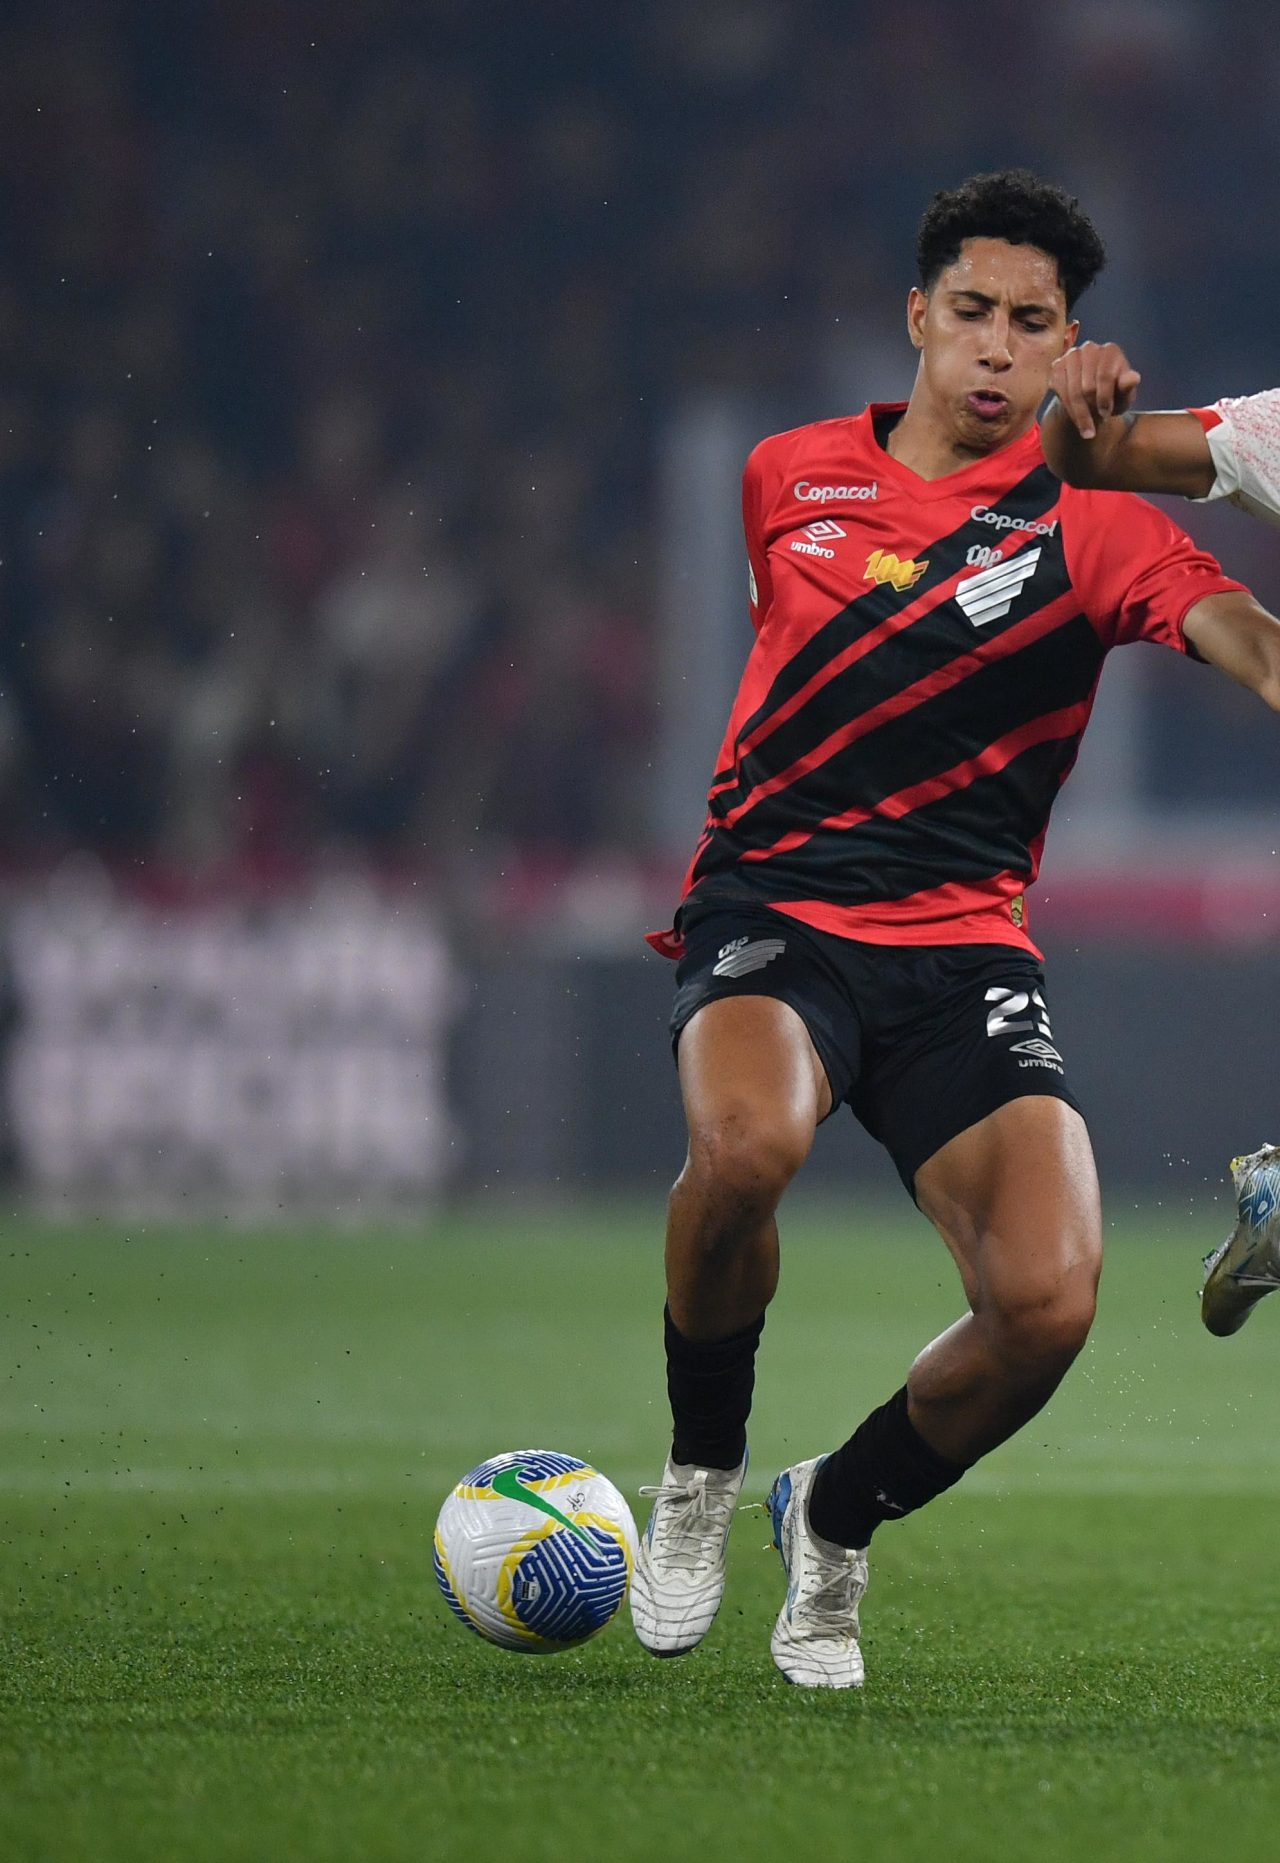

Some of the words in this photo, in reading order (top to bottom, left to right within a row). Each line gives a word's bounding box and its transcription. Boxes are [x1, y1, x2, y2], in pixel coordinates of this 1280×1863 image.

[793, 481, 878, 504] Copacol
[970, 504, 1058, 537] Copacol
[790, 541, 835, 559] umbro
